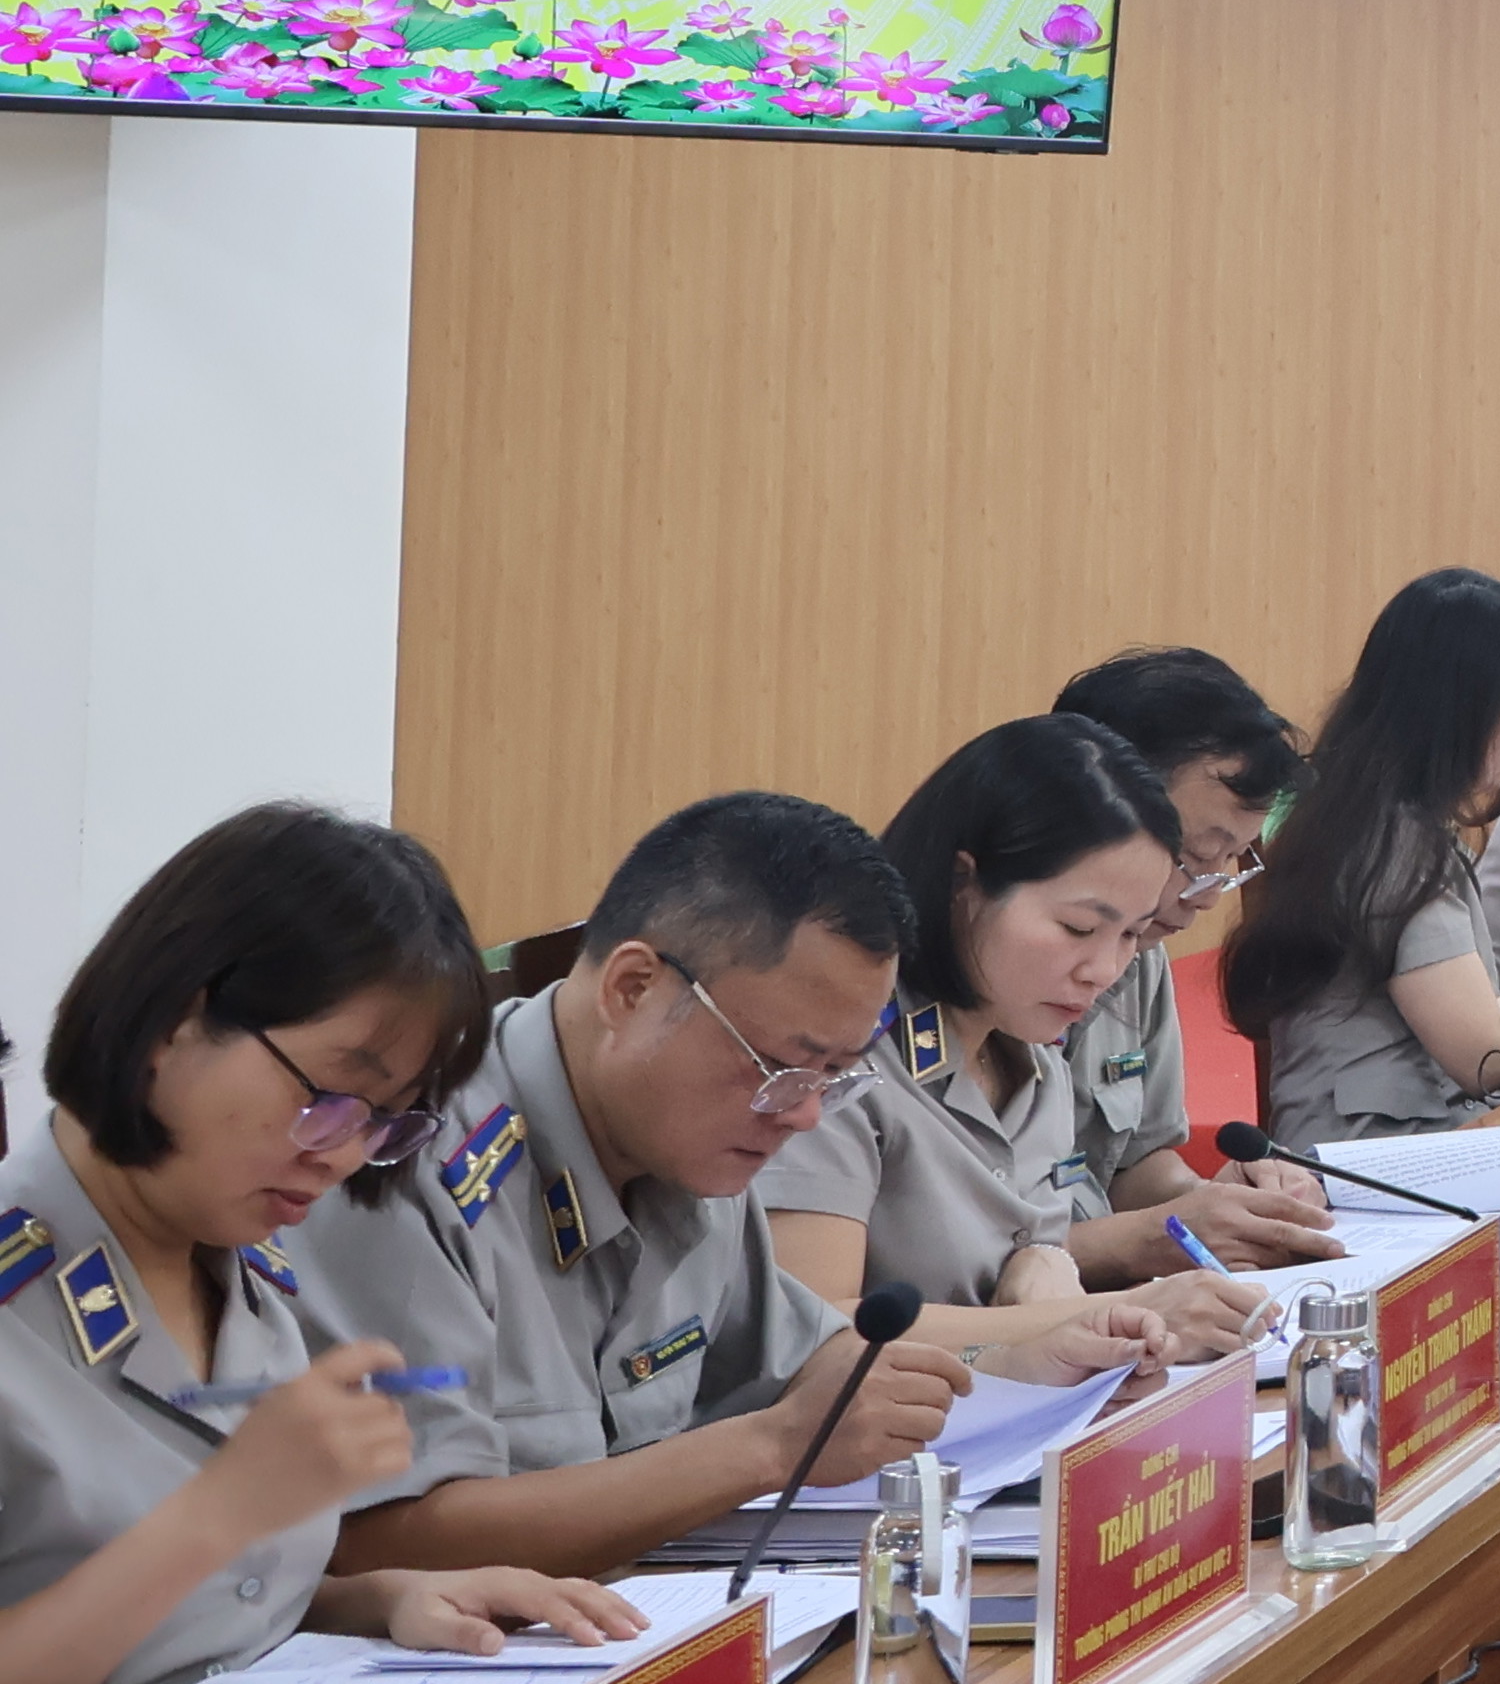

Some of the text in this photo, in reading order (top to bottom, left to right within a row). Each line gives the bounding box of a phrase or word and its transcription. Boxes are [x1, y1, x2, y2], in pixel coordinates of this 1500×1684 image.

[1098, 1450, 1216, 1564] TRẦN VIẾT HẢI
